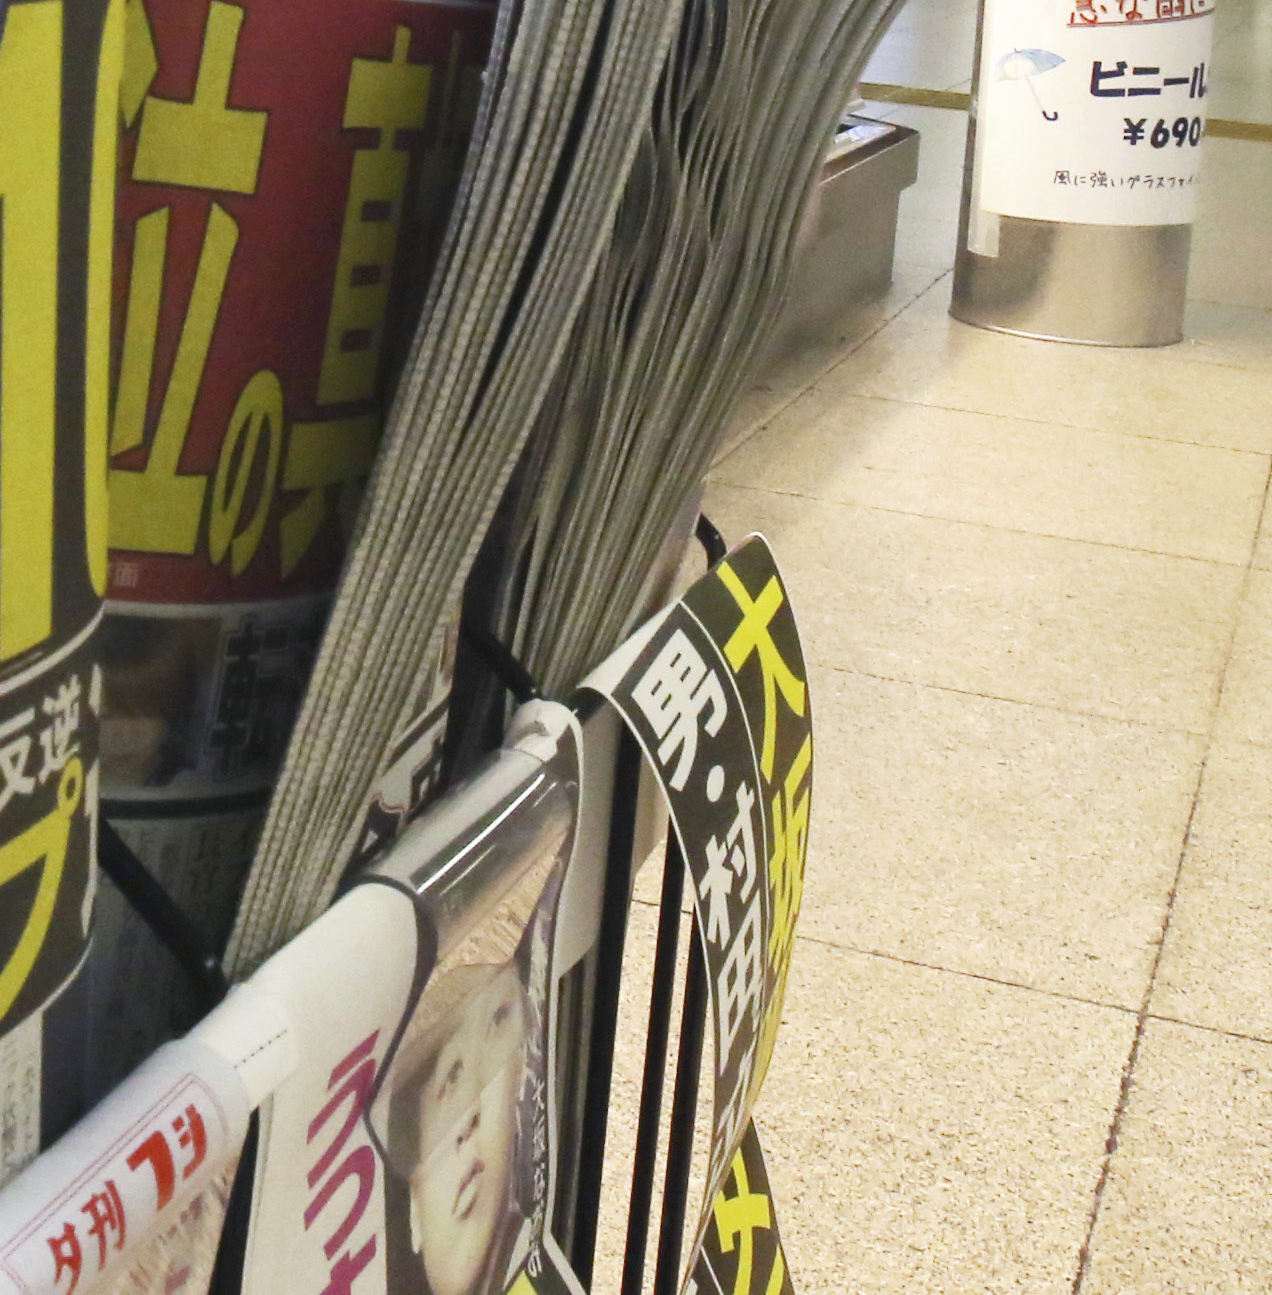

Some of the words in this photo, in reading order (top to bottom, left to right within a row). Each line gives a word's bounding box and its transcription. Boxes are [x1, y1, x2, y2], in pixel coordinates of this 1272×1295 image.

[1090, 60, 1207, 99] ビニール
[631, 628, 764, 1126] 男・村田
[45, 1103, 207, 1295] 夕刊フジ
